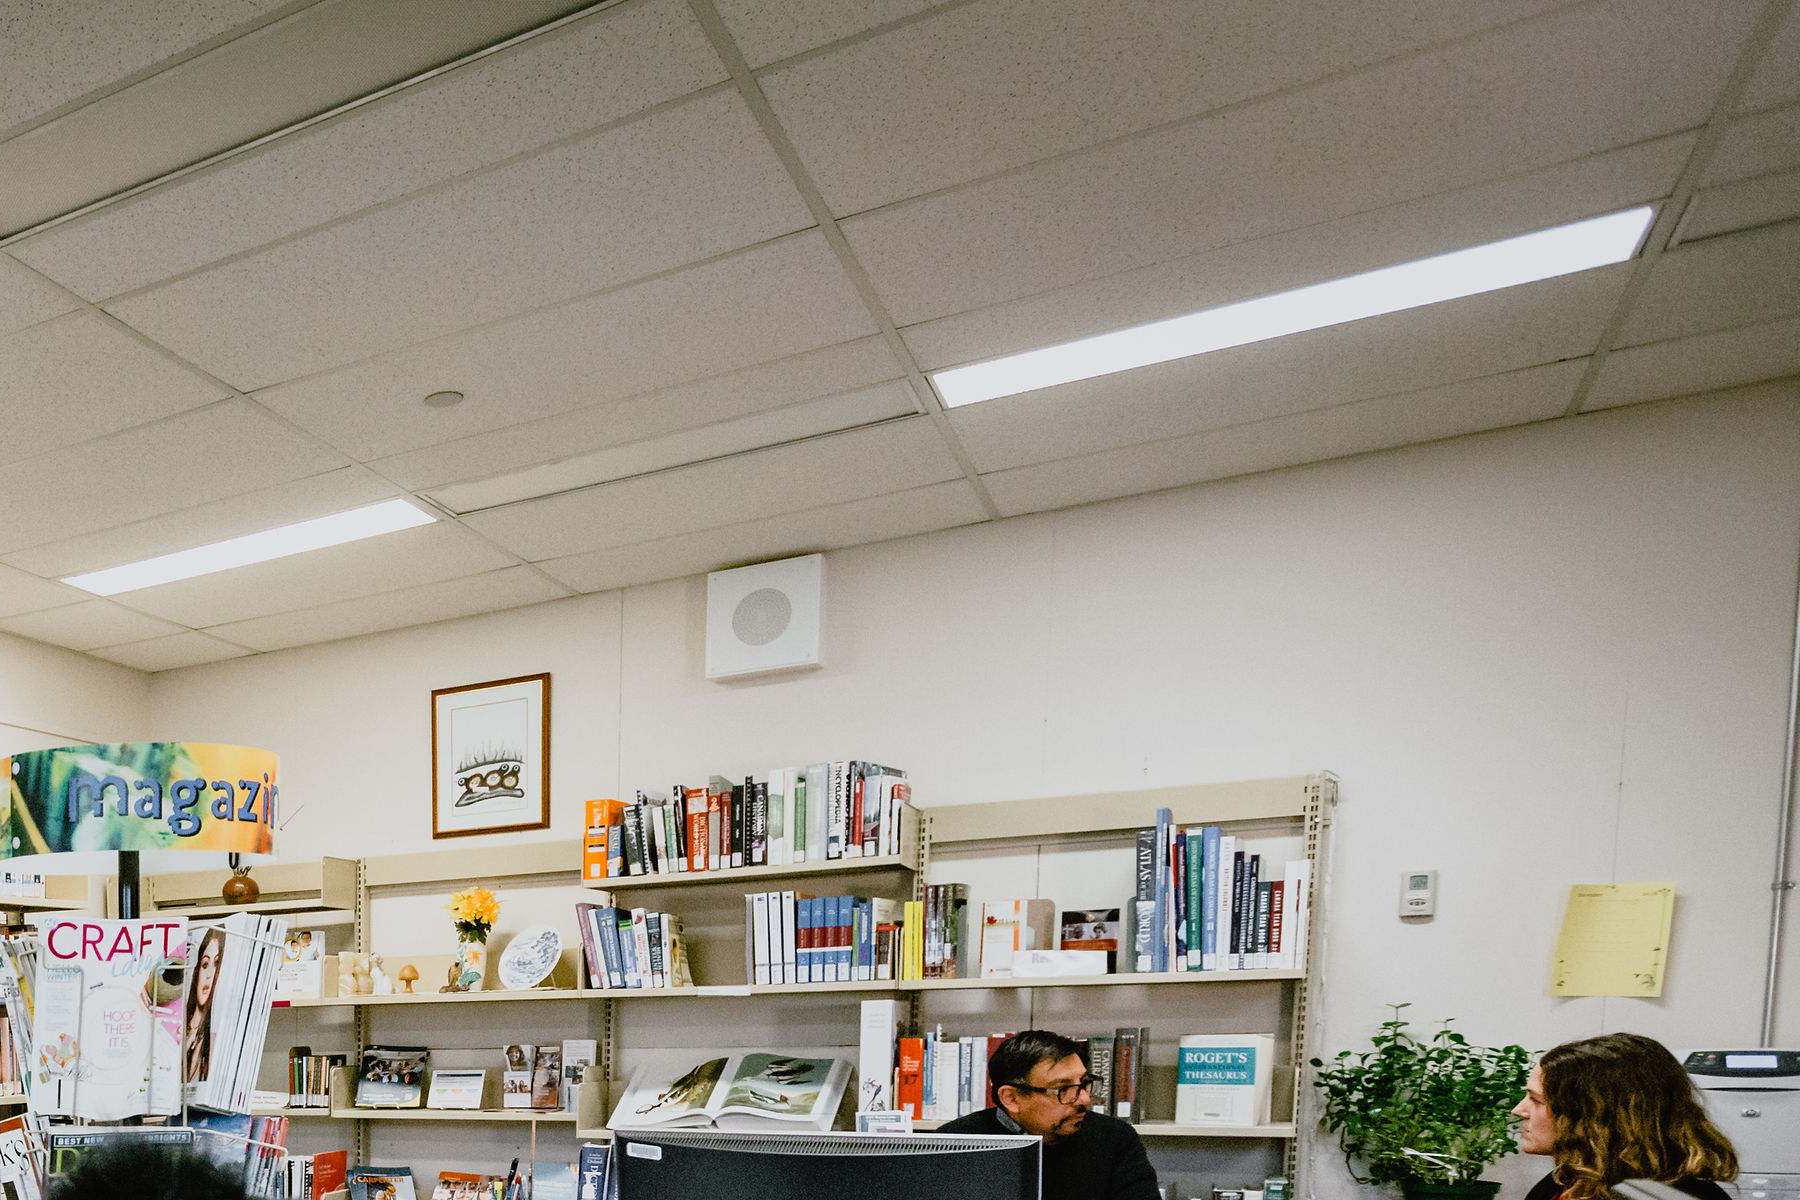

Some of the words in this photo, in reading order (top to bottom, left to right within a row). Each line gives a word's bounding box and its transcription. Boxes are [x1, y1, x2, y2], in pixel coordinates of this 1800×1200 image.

[1140, 847, 1151, 881] ATLAS
[1259, 915, 1267, 928] YEAR
[1273, 913, 1281, 927] YEAR
[1272, 928, 1280, 943] BOOK
[47, 922, 180, 963] CRAFT
[103, 1023, 136, 1035] THERE
[1185, 1052, 1248, 1064] ROGET'S
[1100, 1050, 1110, 1098] CANADIAN
[1184, 1071, 1248, 1080] THESAURUS
[57, 1137, 81, 1145] BEST
[83, 1136, 104, 1144] NEW
[357, 1176, 404, 1184] CARPENTER
